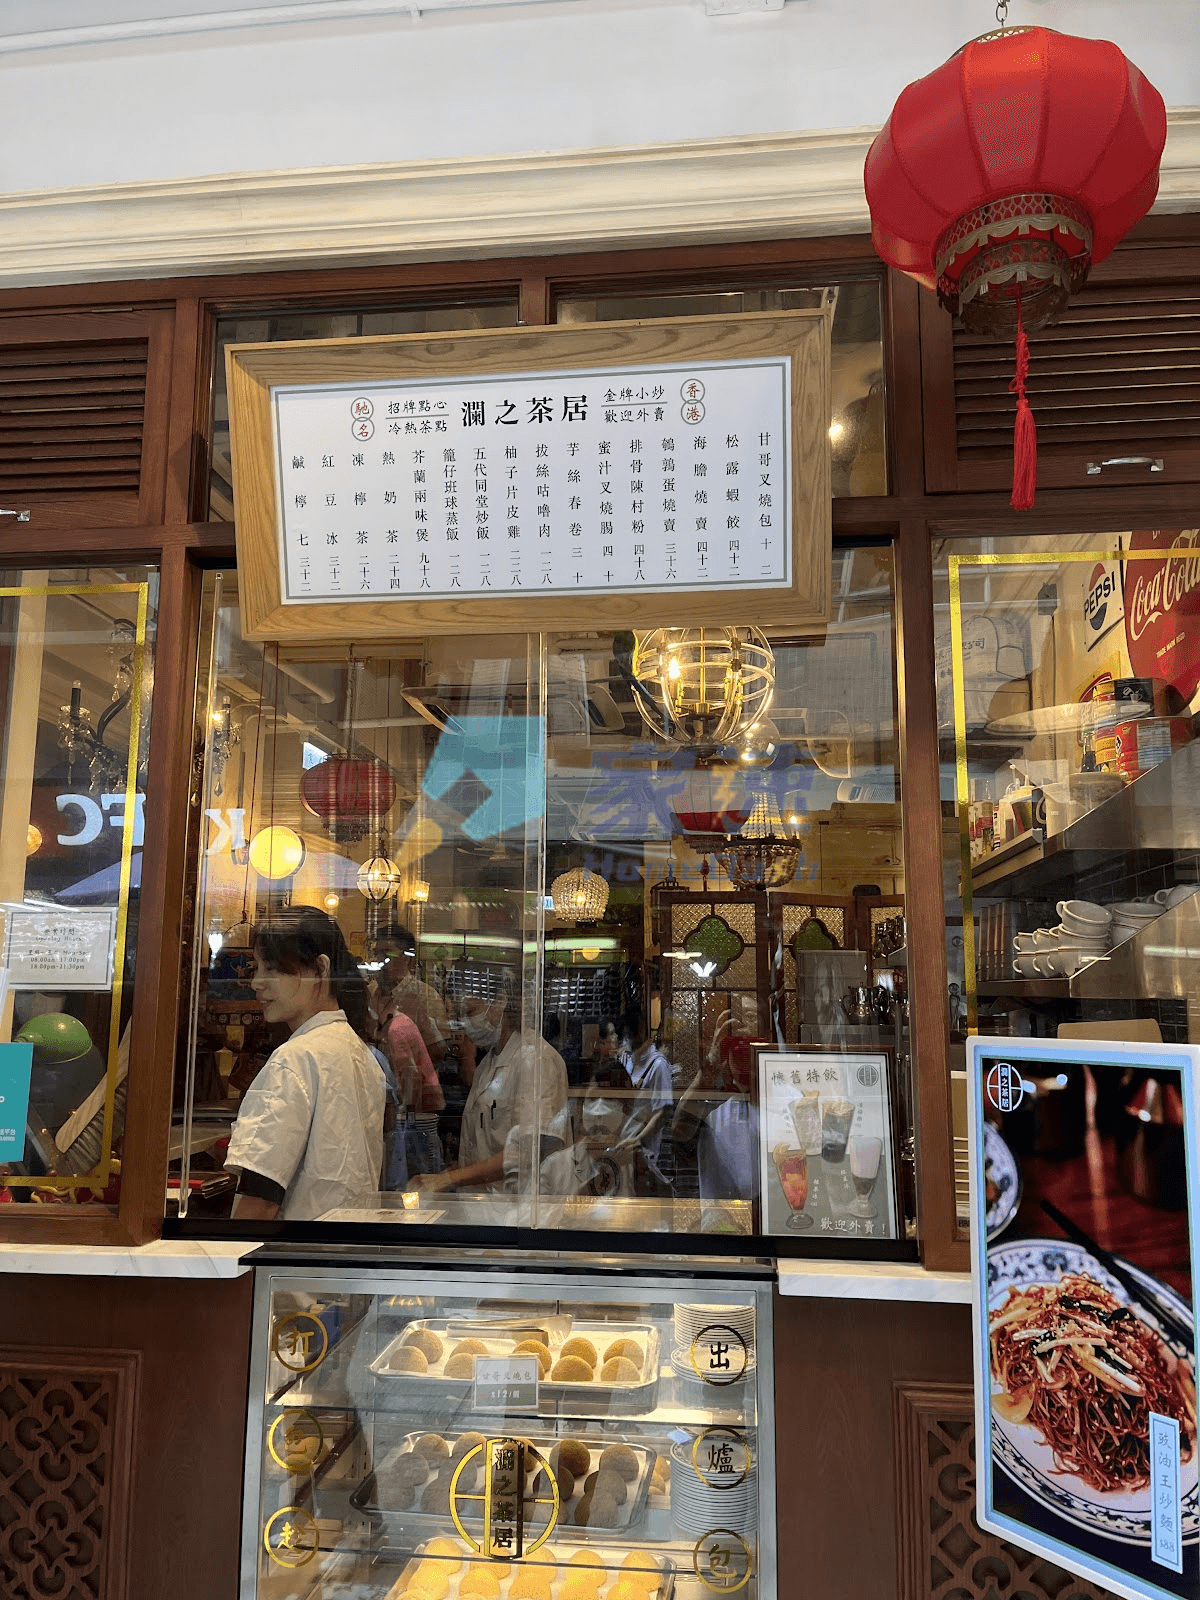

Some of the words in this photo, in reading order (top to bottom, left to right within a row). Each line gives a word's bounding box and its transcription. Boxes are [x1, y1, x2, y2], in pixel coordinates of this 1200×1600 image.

[354, 400, 370, 438] 馳名
[387, 399, 448, 415] 招牌點心
[388, 419, 448, 436] 冷熱茶點
[460, 394, 589, 427] 瀾之茶居
[603, 385, 665, 403] 金牌小炒
[603, 406, 665, 424] 歡迎外賣
[686, 382, 701, 421] 香港
[321, 454, 339, 545] 紅豆冰
[351, 452, 369, 544] 凍檸茶
[382, 451, 399, 543] 熱奶茶
[412, 449, 429, 543] 芥蘭兩味煲
[442, 447, 460, 541] 籠仔班球蒸飯
[473, 446, 490, 540] 五代同堂炒飯
[504, 445, 521, 539] 柚子片皮雞
[535, 443, 551, 538] 拔絲咕嚕肉
[566, 442, 583, 537] 芋絲春卷
[598, 440, 614, 535] 蜜汁叉燒腸
[629, 438, 645, 534] 排骨陳村粉
[661, 437, 677, 533] 鵪鶉蛋燒賣
[693, 435, 708, 531] 海膽燒賣
[725, 433, 740, 530] 松露蝦餃
[757, 431, 773, 528] 甘哥叉燒包
[1084, 570, 1116, 620] PEPSI
